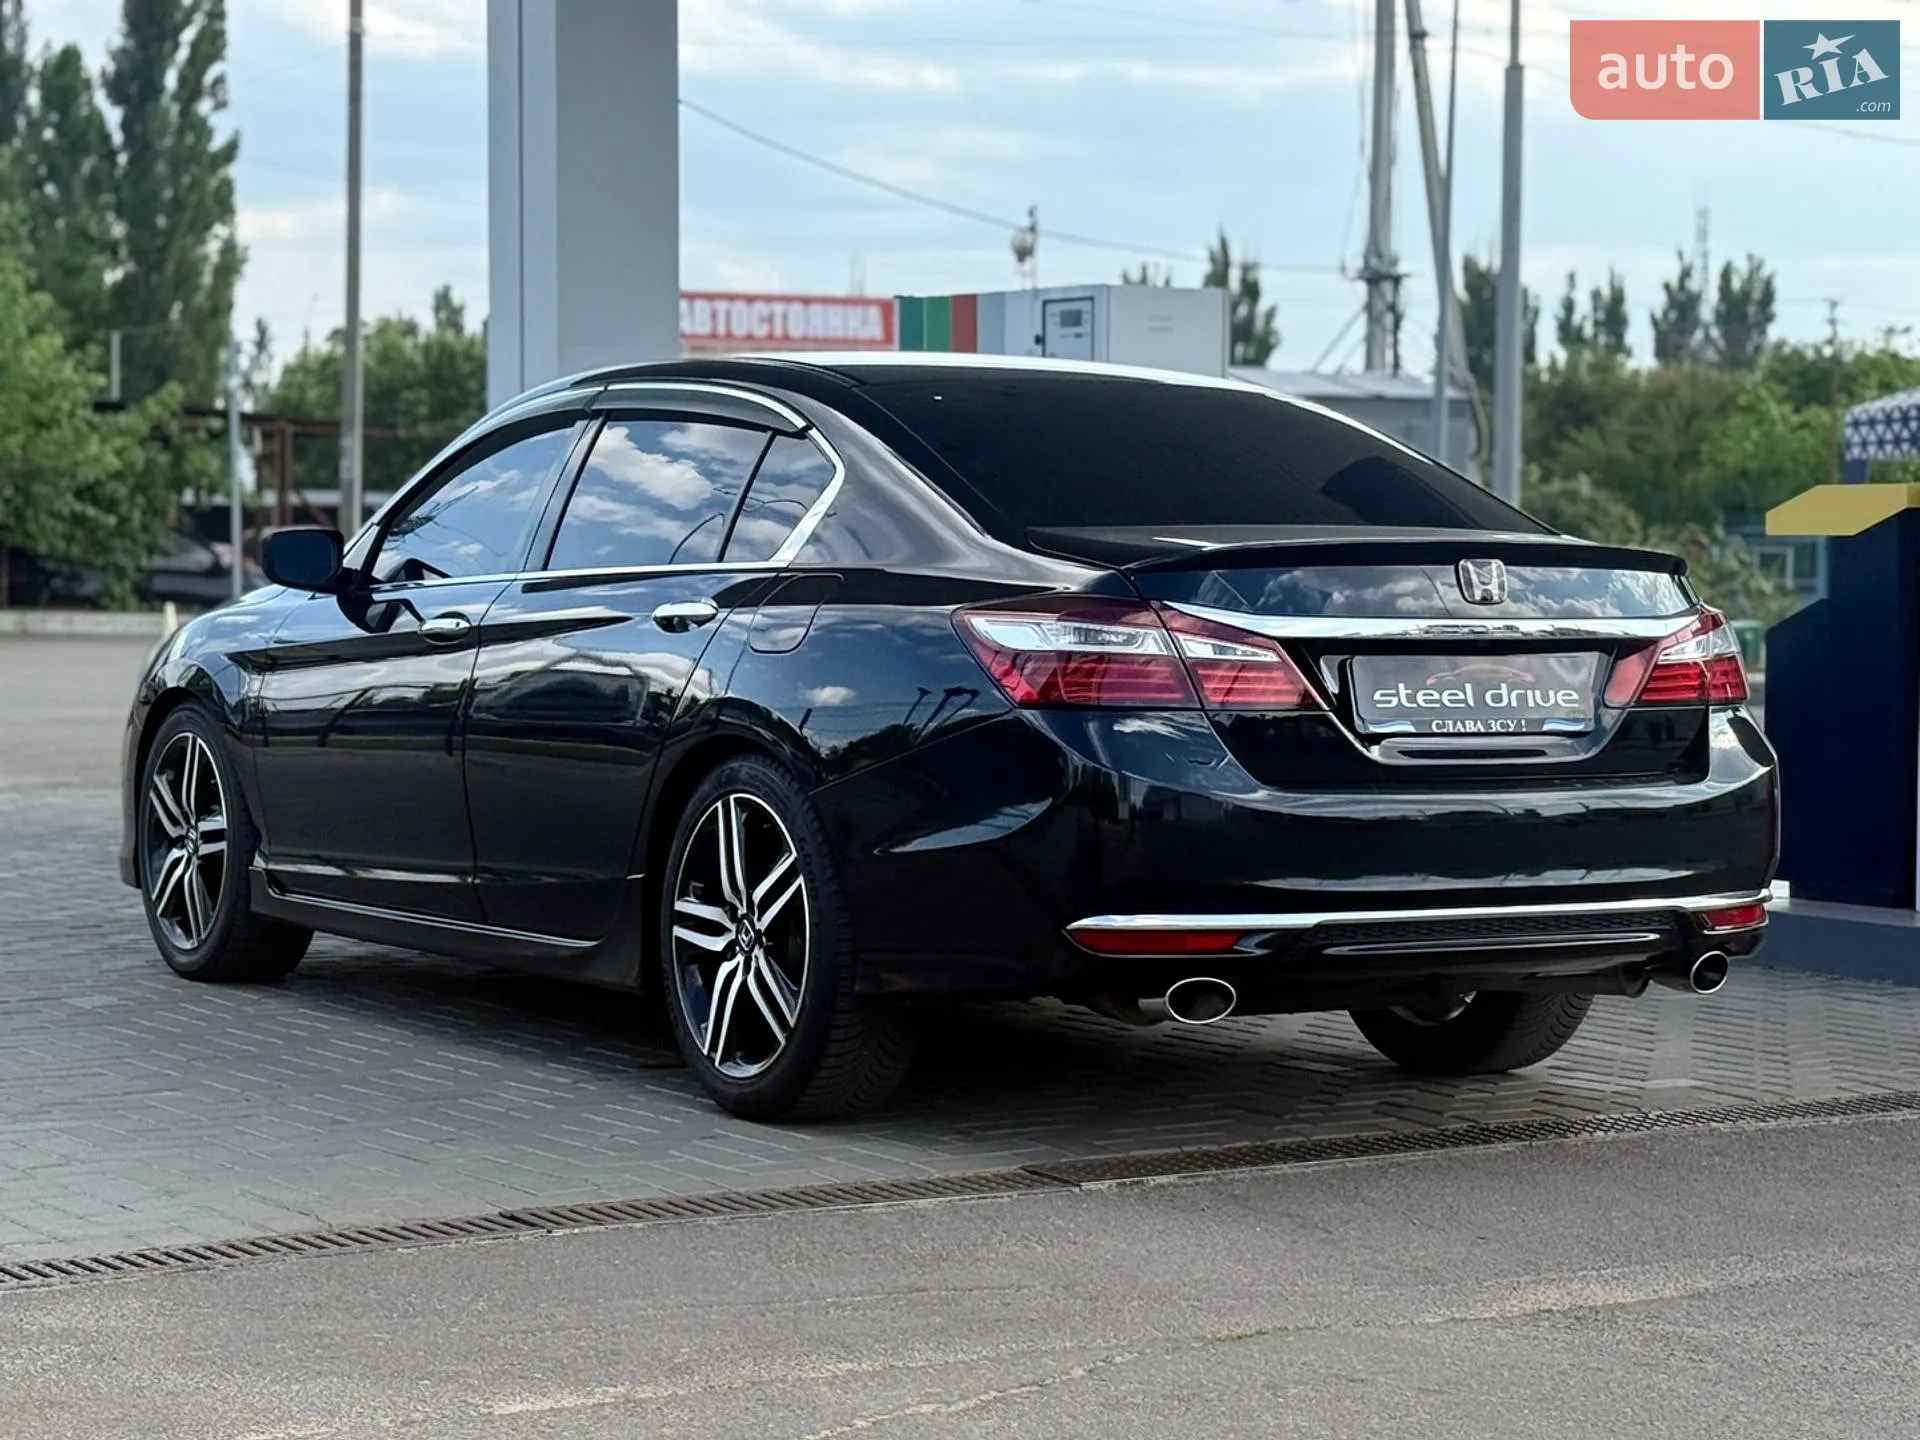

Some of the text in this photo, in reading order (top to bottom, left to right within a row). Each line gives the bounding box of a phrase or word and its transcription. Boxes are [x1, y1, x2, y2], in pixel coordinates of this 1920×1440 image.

[680, 297, 884, 341] АВТОСТОЯНКА
[1373, 683, 1579, 708] steel drive
[1431, 719, 1485, 733] СЛАВА
